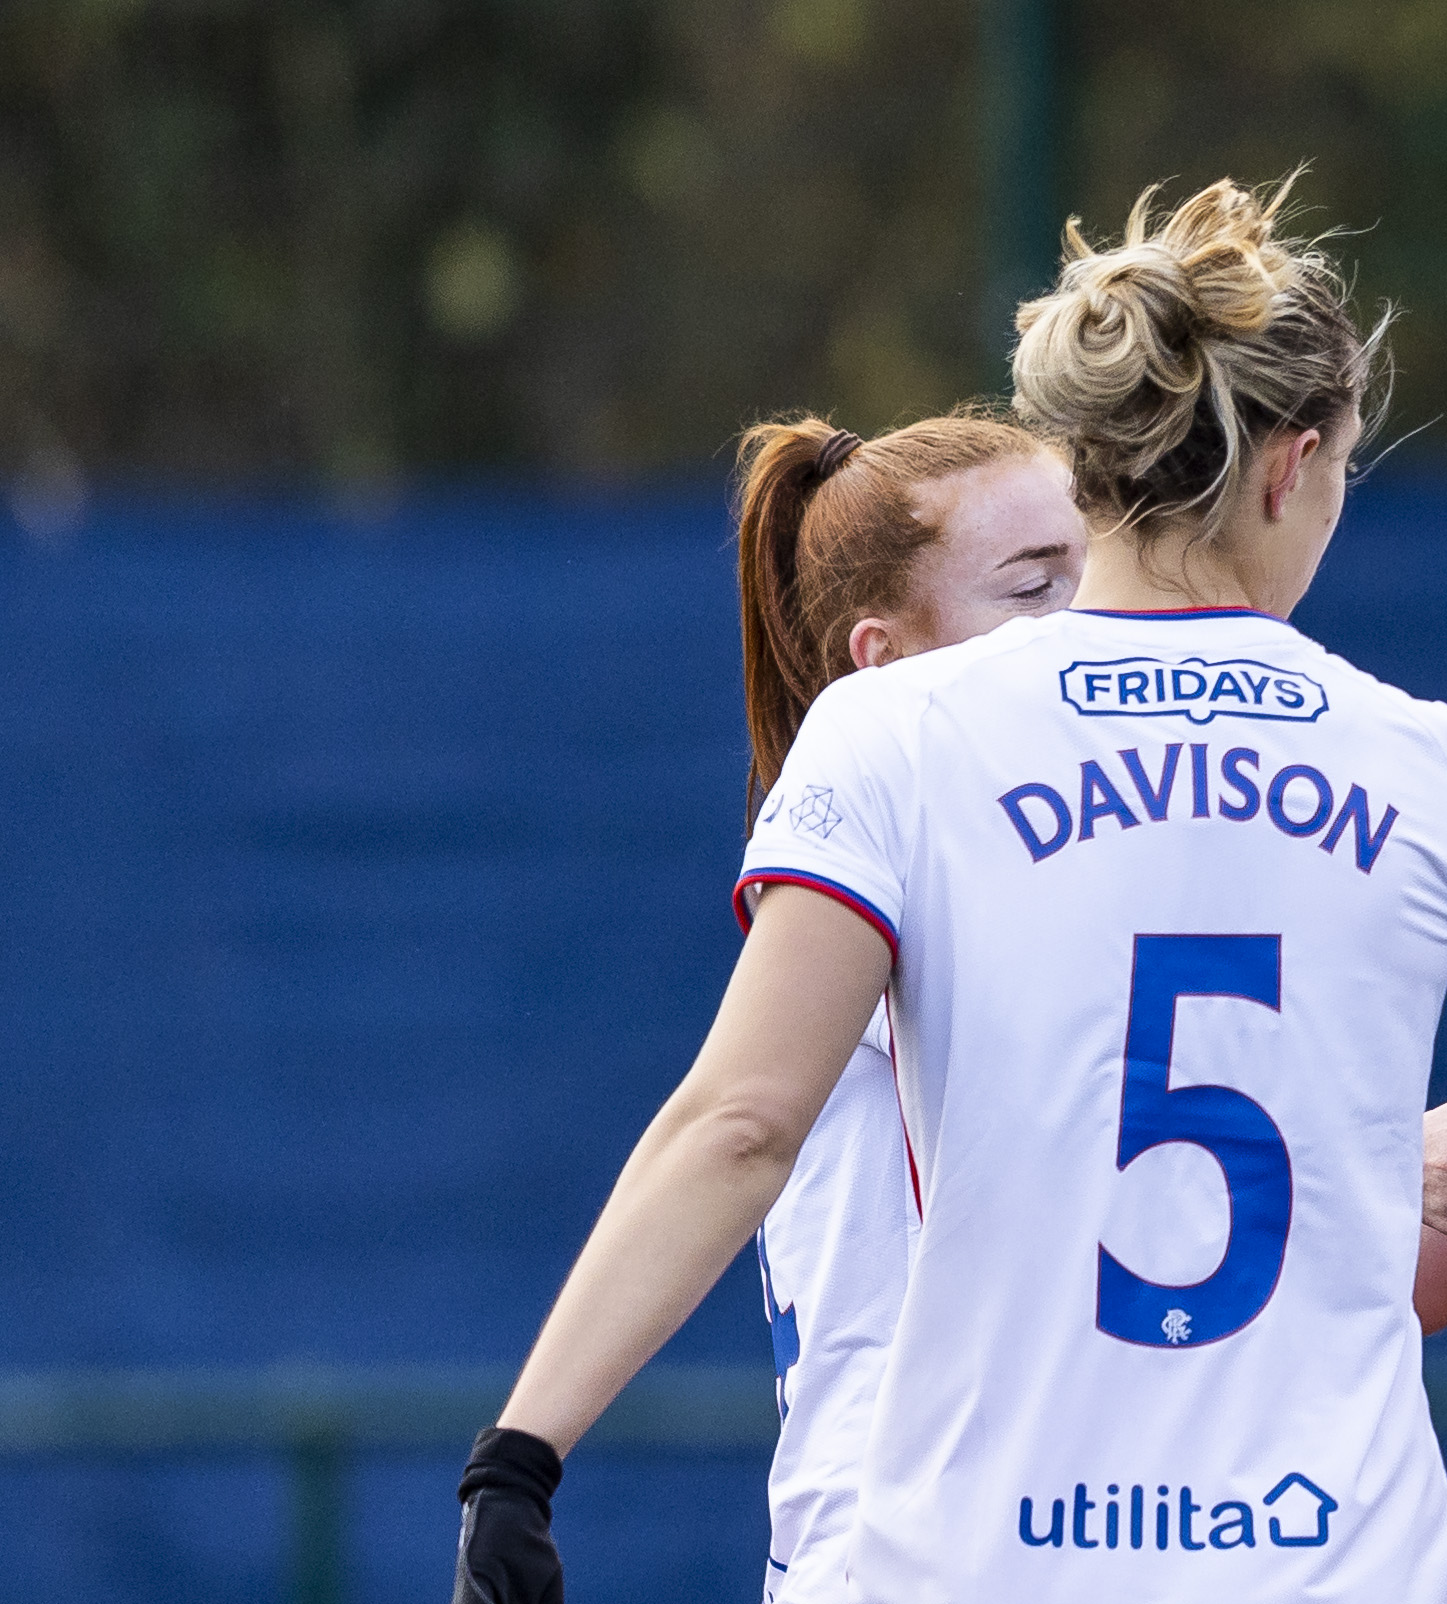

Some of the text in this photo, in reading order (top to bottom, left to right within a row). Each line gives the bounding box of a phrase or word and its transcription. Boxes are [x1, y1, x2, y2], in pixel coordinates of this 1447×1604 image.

[1085, 670, 1305, 711] FRIDAYS
[998, 743, 1399, 875] DAVISON
[1096, 932, 1294, 1348] 5
[1019, 1482, 1256, 1551] utilita
